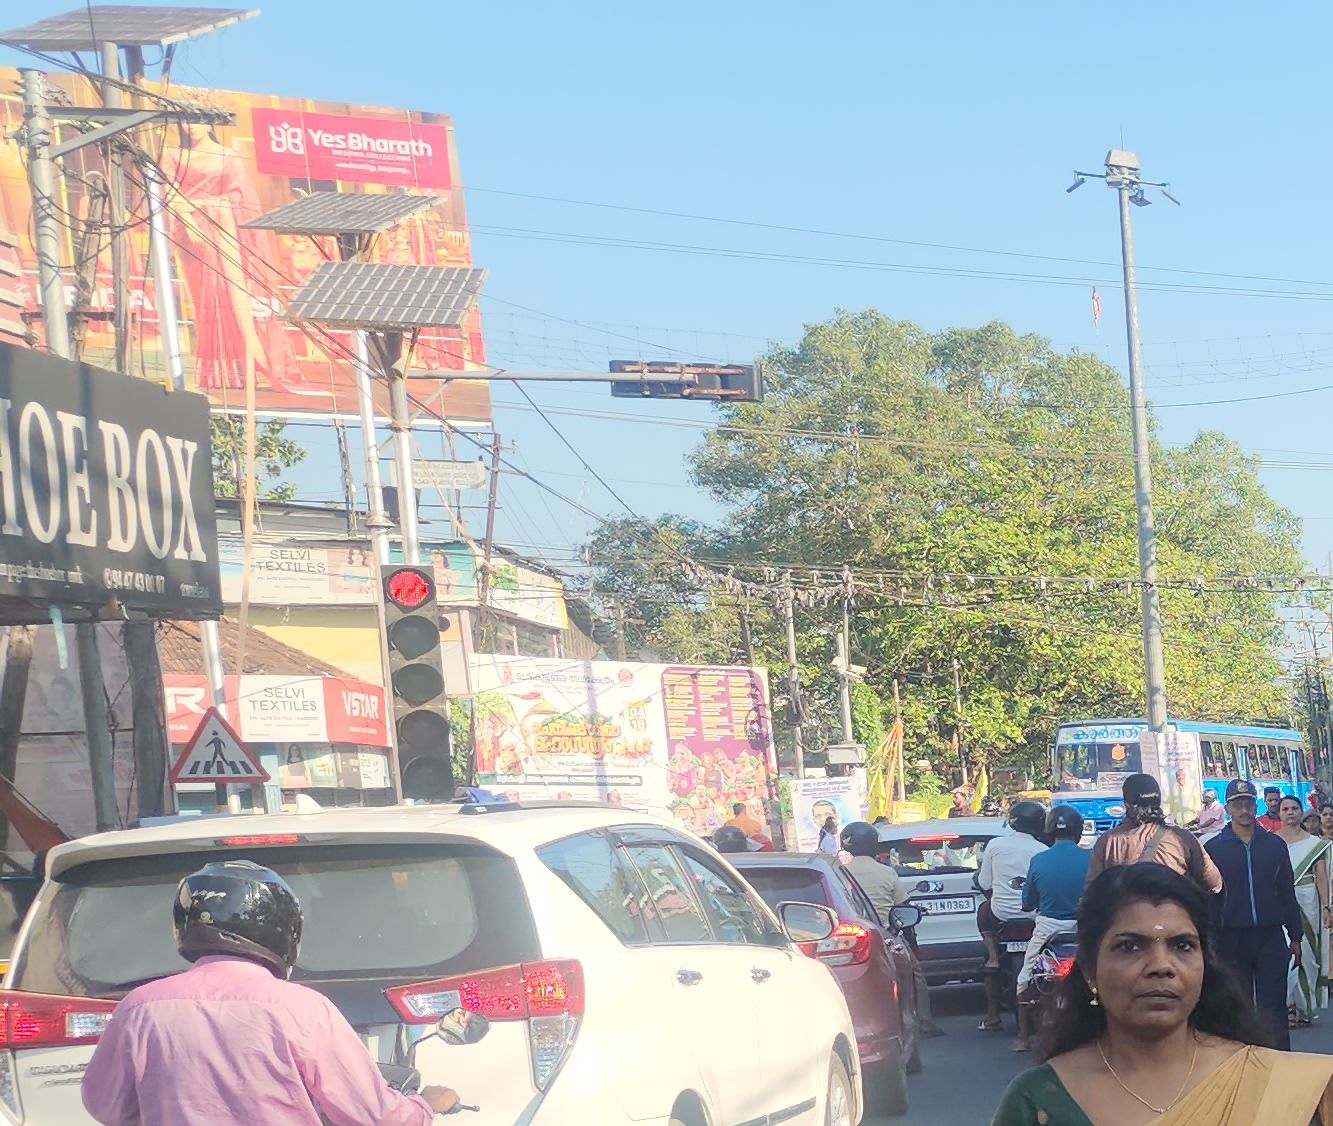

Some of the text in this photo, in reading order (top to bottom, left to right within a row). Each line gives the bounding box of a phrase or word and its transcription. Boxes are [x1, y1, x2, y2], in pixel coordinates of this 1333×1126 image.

[98, 420, 207, 562] BOX
[270, 549, 311, 560] SELVI
[256, 562, 326, 573] TEXTILES
[264, 687, 305, 698] SELVI
[249, 700, 317, 711] TEXTILES
